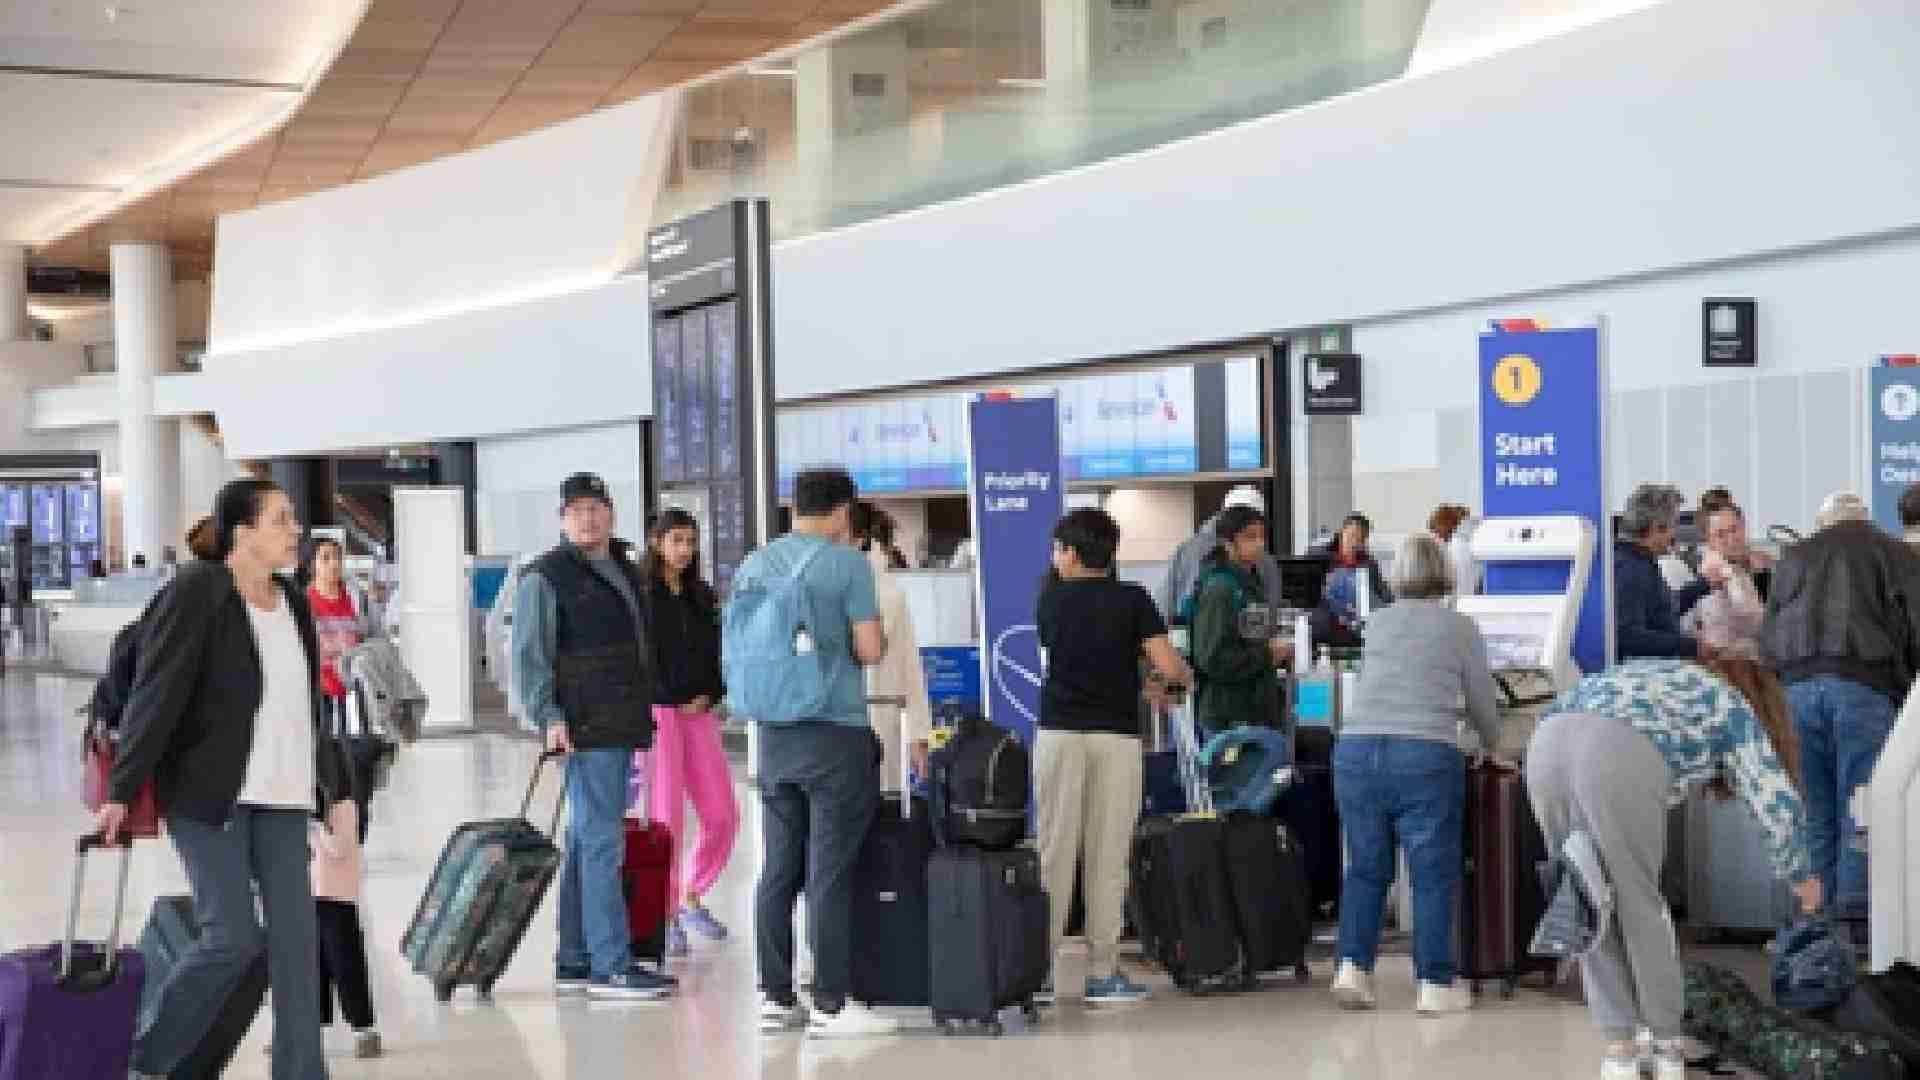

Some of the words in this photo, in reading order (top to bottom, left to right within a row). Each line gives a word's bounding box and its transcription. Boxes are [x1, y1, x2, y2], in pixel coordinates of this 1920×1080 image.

[1508, 366, 1521, 392] 1
[1495, 432, 1556, 455] Start
[984, 471, 1050, 493] Priority
[1495, 463, 1558, 486] Here
[984, 494, 1028, 512] Lane
